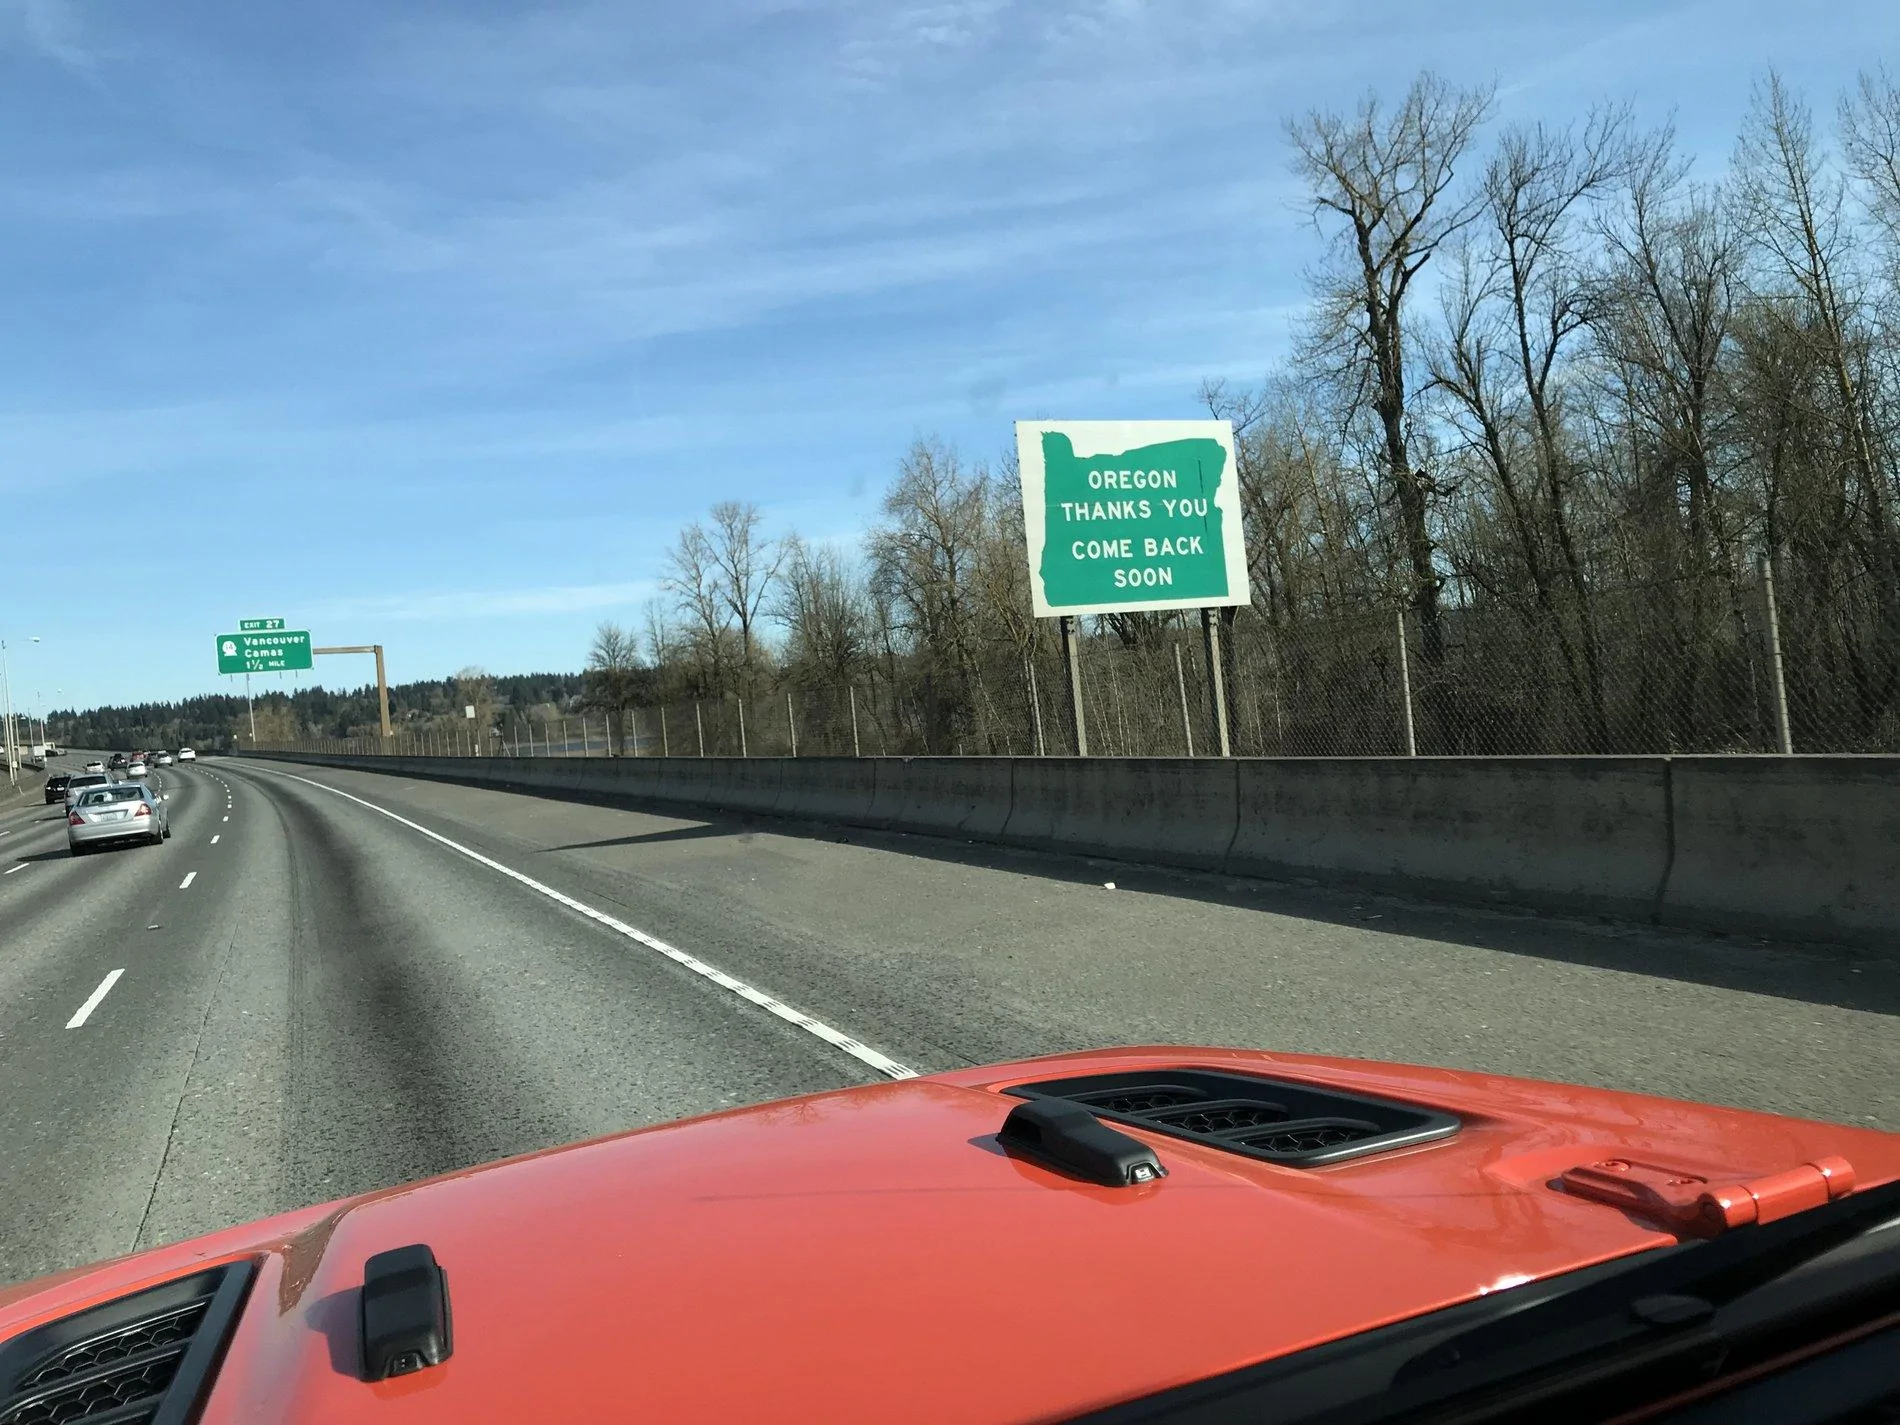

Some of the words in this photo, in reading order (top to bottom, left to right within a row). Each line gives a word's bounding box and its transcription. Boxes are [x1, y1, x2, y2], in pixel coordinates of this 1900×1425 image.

[1088, 470, 1177, 490] OREGON
[1060, 500, 1152, 522] THANKS
[1162, 498, 1208, 518] YOU
[1072, 539, 1133, 560] COME
[1144, 536, 1204, 557] BACK
[1114, 567, 1173, 588] SOON
[244, 621, 261, 629] EXIT
[265, 619, 280, 629] 27
[243, 635, 305, 646] Vancouver
[244, 648, 284, 658] Camas
